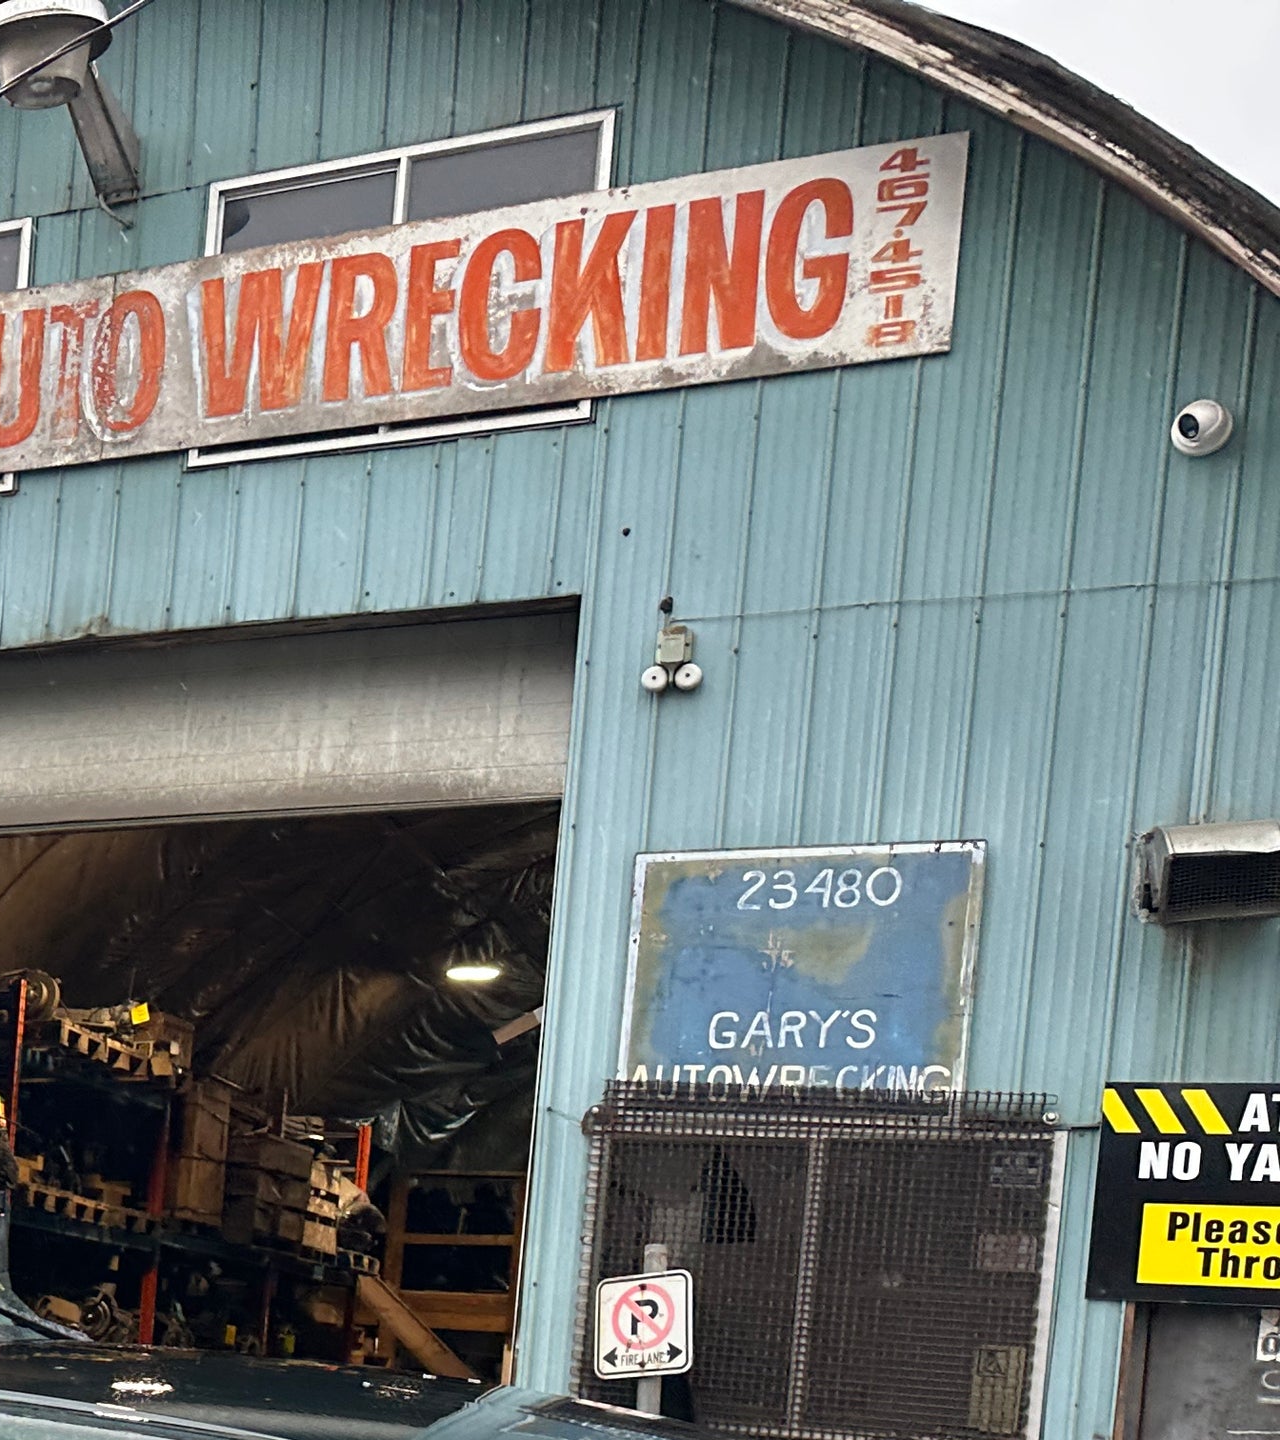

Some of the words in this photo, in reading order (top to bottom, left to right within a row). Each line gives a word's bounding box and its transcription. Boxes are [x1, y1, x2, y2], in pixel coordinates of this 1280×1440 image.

[197, 176, 856, 419] WRECKING
[736, 866, 903, 911] 23480
[707, 1008, 878, 1050] GARY'S
[1138, 1141, 1202, 1181] NO
[1167, 1211, 1280, 1245] Pleas
[620, 1353, 640, 1367] FIRE
[642, 1351, 667, 1365] LANE
